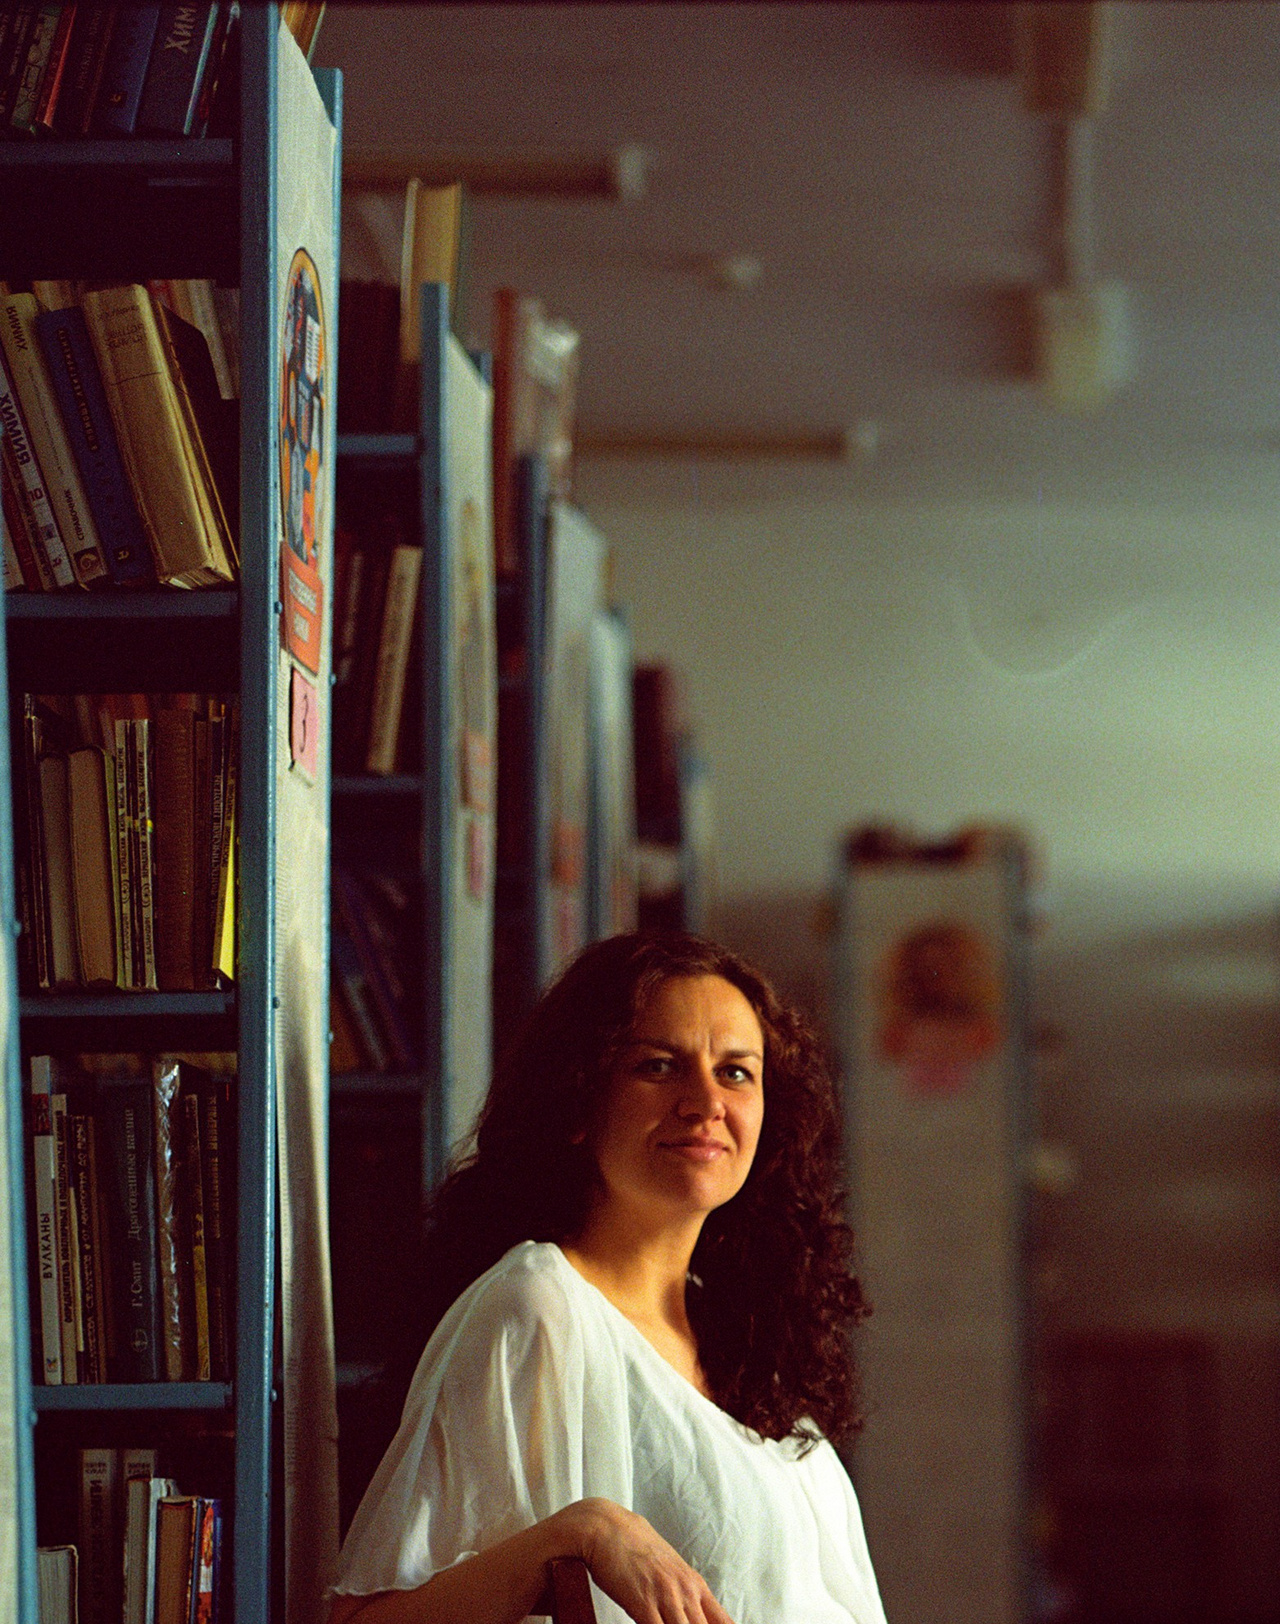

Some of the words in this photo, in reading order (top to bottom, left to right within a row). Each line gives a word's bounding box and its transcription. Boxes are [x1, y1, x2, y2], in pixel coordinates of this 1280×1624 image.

[6, 305, 29, 352] ХИМИЯ
[0, 392, 31, 466] ХИМИЯ
[56, 1143, 67, 1200] ПОДЕЛОЧНЫХ
[125, 1153, 143, 1242] Драгоценные
[40, 1212, 53, 1280] ВУЛКАНЫ
[59, 1209, 71, 1260] ЮВЕЛИРНЫХ
[62, 1261, 73, 1324] ОПРЕДЕЛИТЕЛЬ
[130, 1260, 143, 1294] Смит
